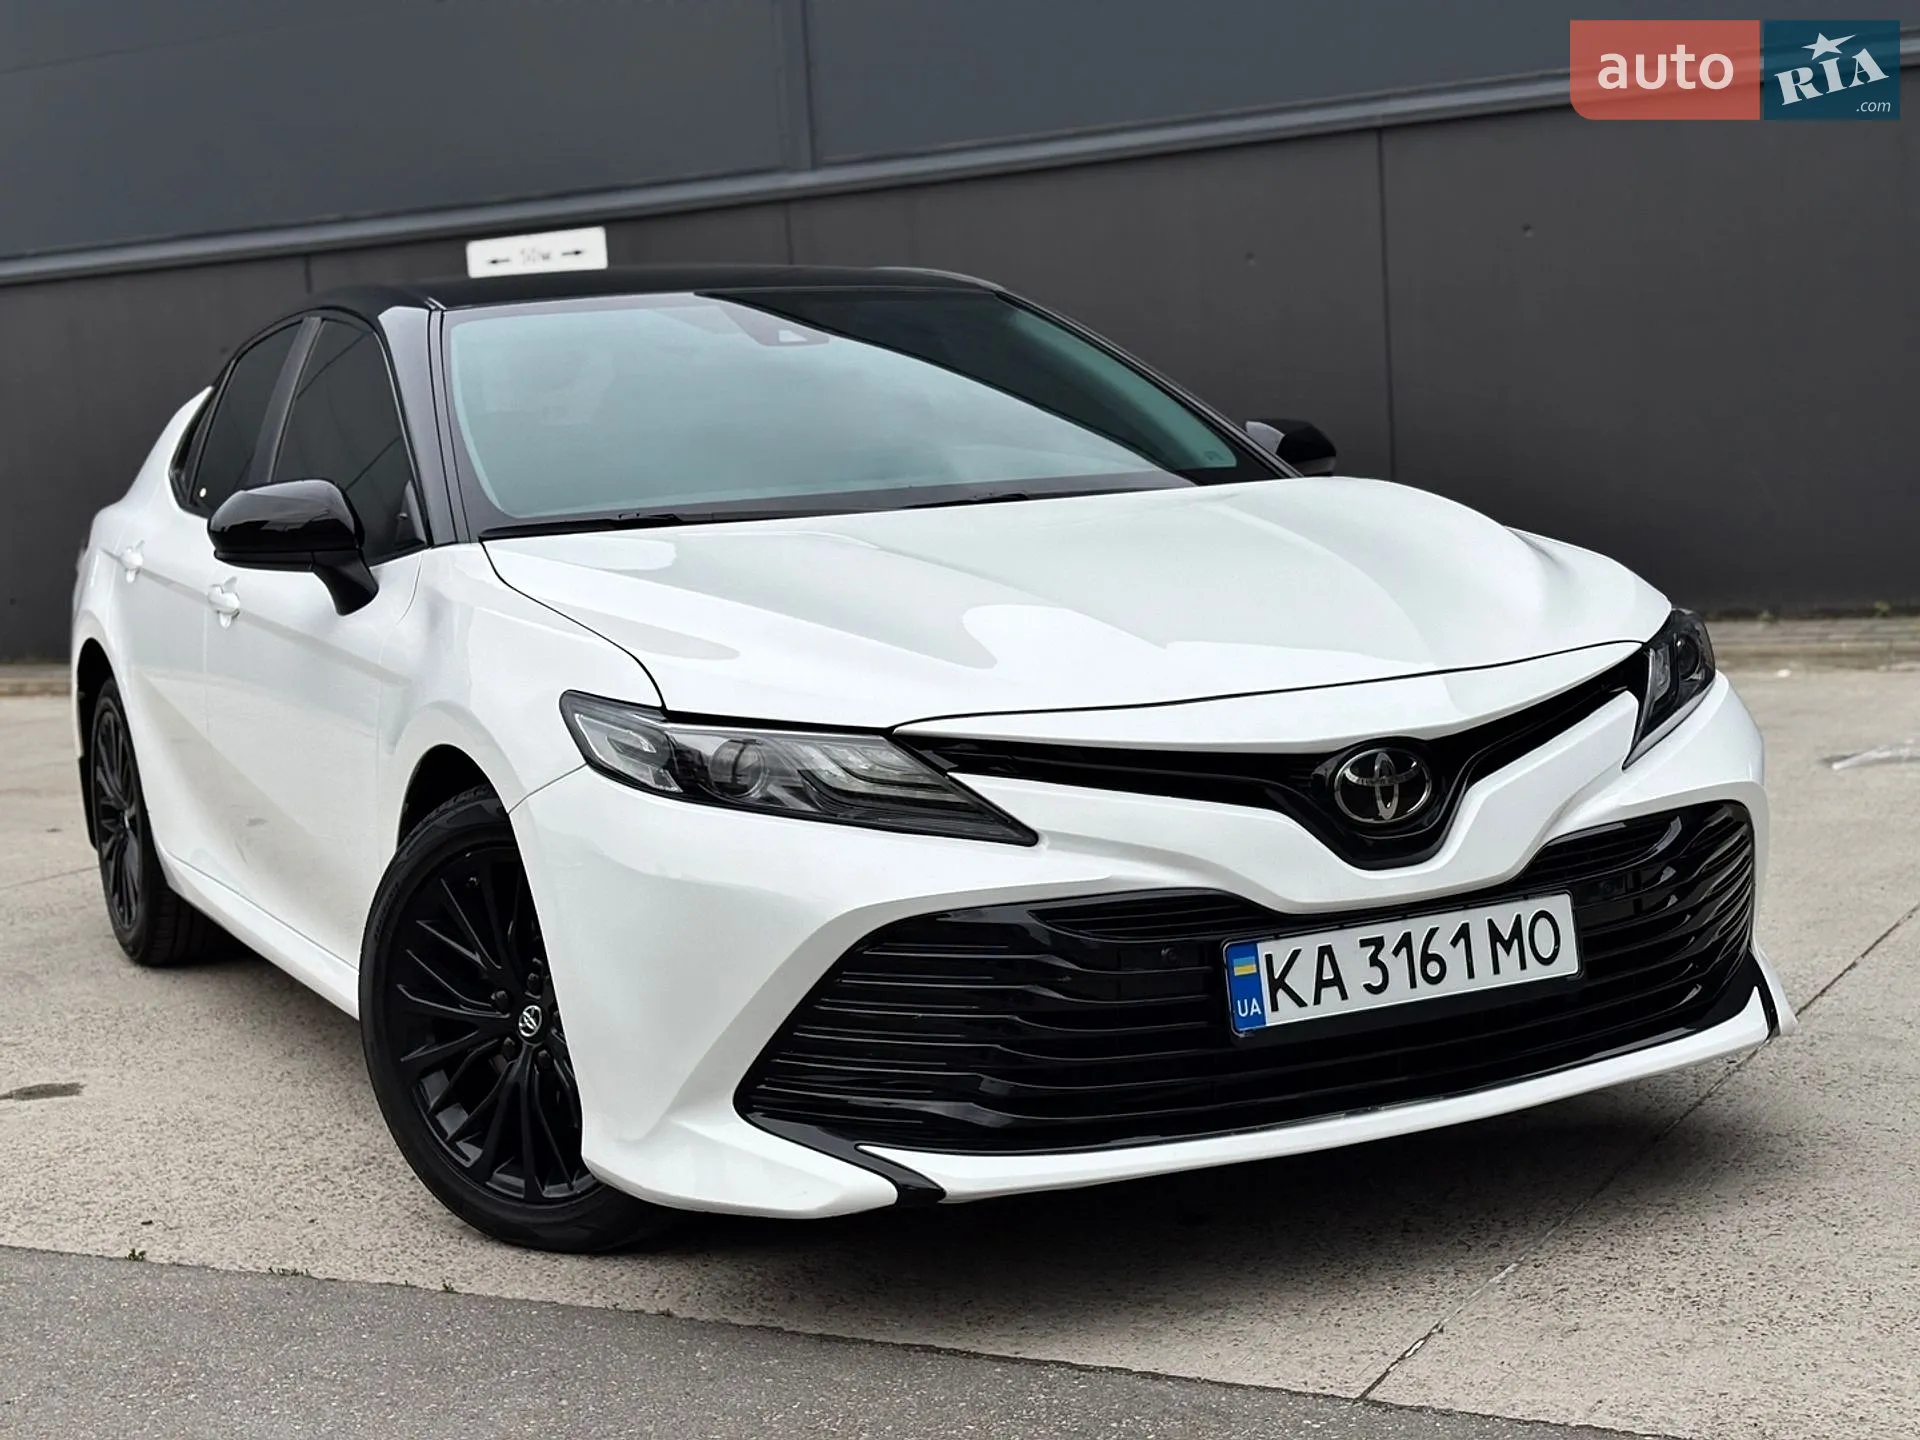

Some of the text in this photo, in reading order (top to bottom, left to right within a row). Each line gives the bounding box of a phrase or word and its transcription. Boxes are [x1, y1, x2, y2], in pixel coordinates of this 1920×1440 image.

[1264, 909, 1561, 1012] KA 3161 MO
[1237, 998, 1262, 1017] UA
